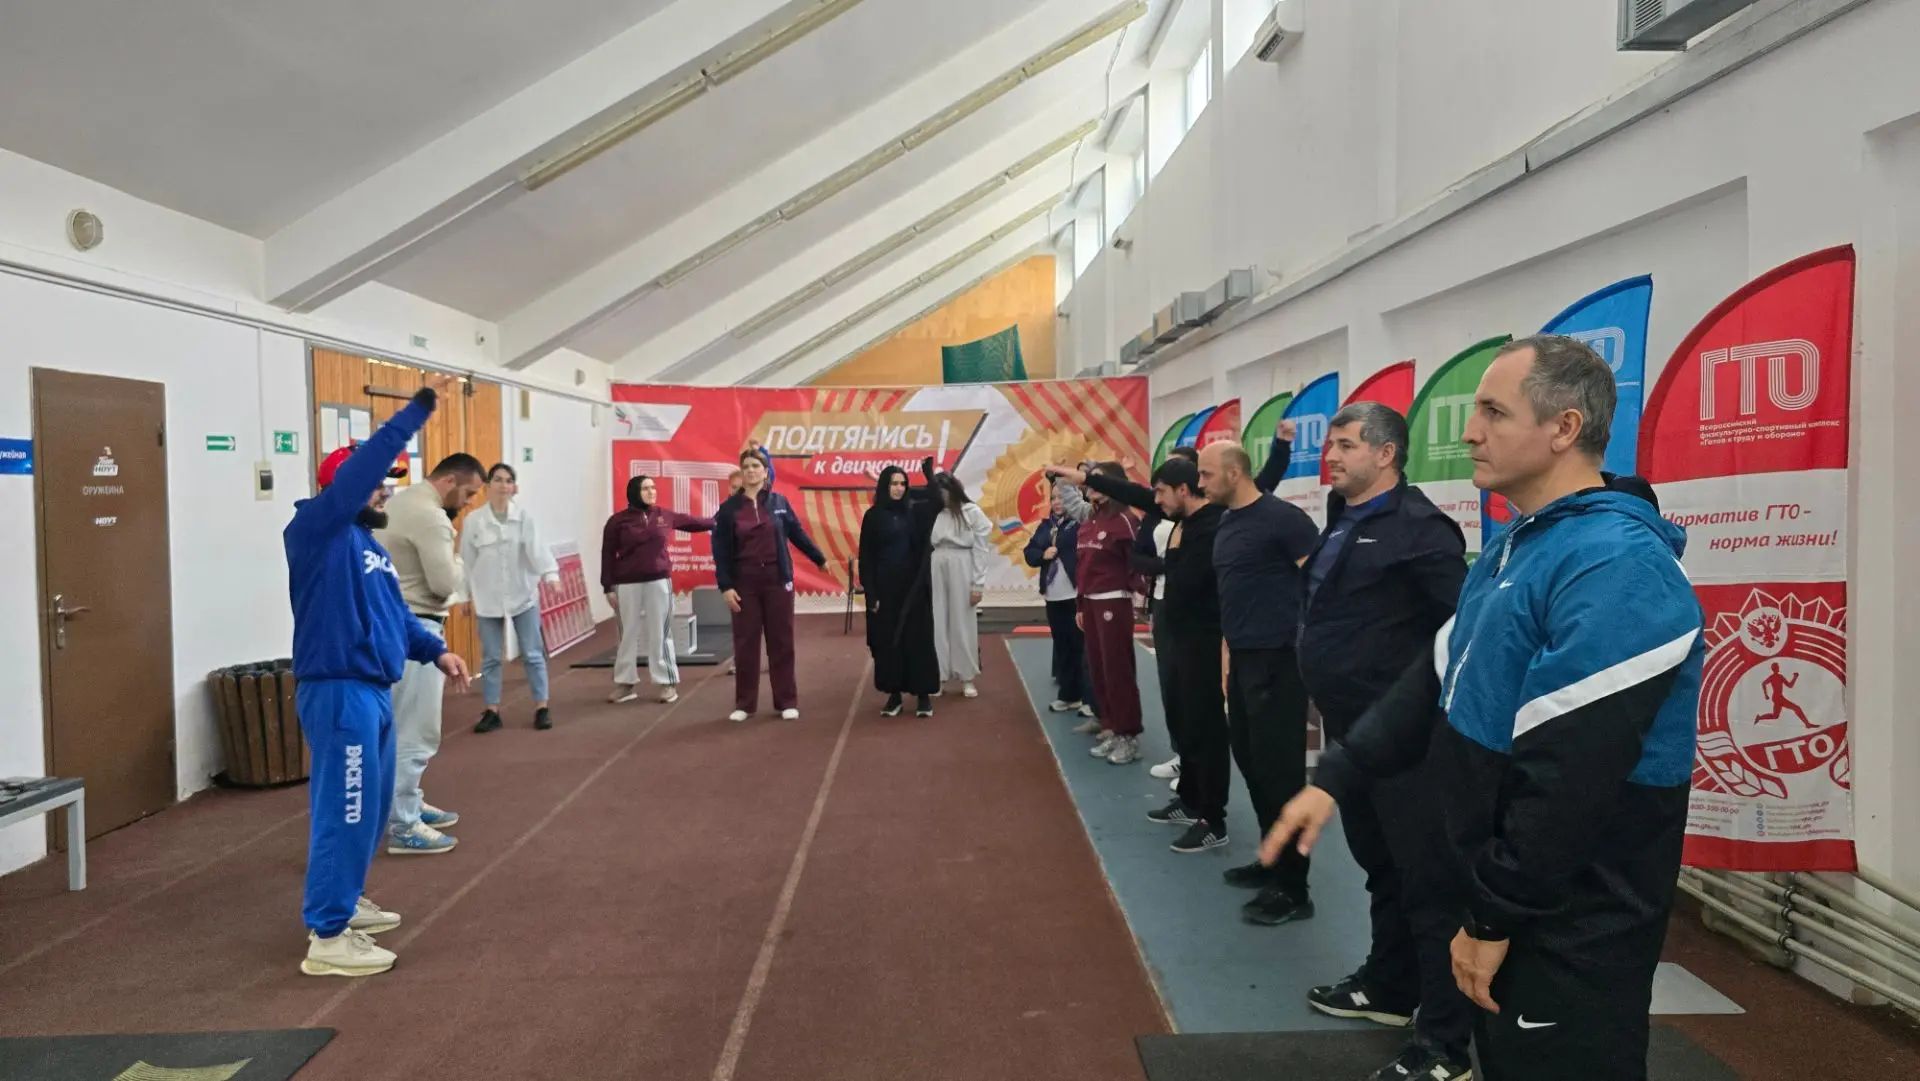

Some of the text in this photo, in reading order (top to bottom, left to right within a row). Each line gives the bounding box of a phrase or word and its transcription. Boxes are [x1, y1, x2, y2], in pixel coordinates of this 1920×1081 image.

[1700, 339, 1819, 420] ГТО
[1428, 393, 1475, 444] ГТ
[0, 450, 27, 460] ужейная
[814, 456, 926, 475] к движени
[1765, 504, 1801, 521] ГТО
[1709, 529, 1838, 553] норма жизни!
[1763, 733, 1834, 770] ГТО
